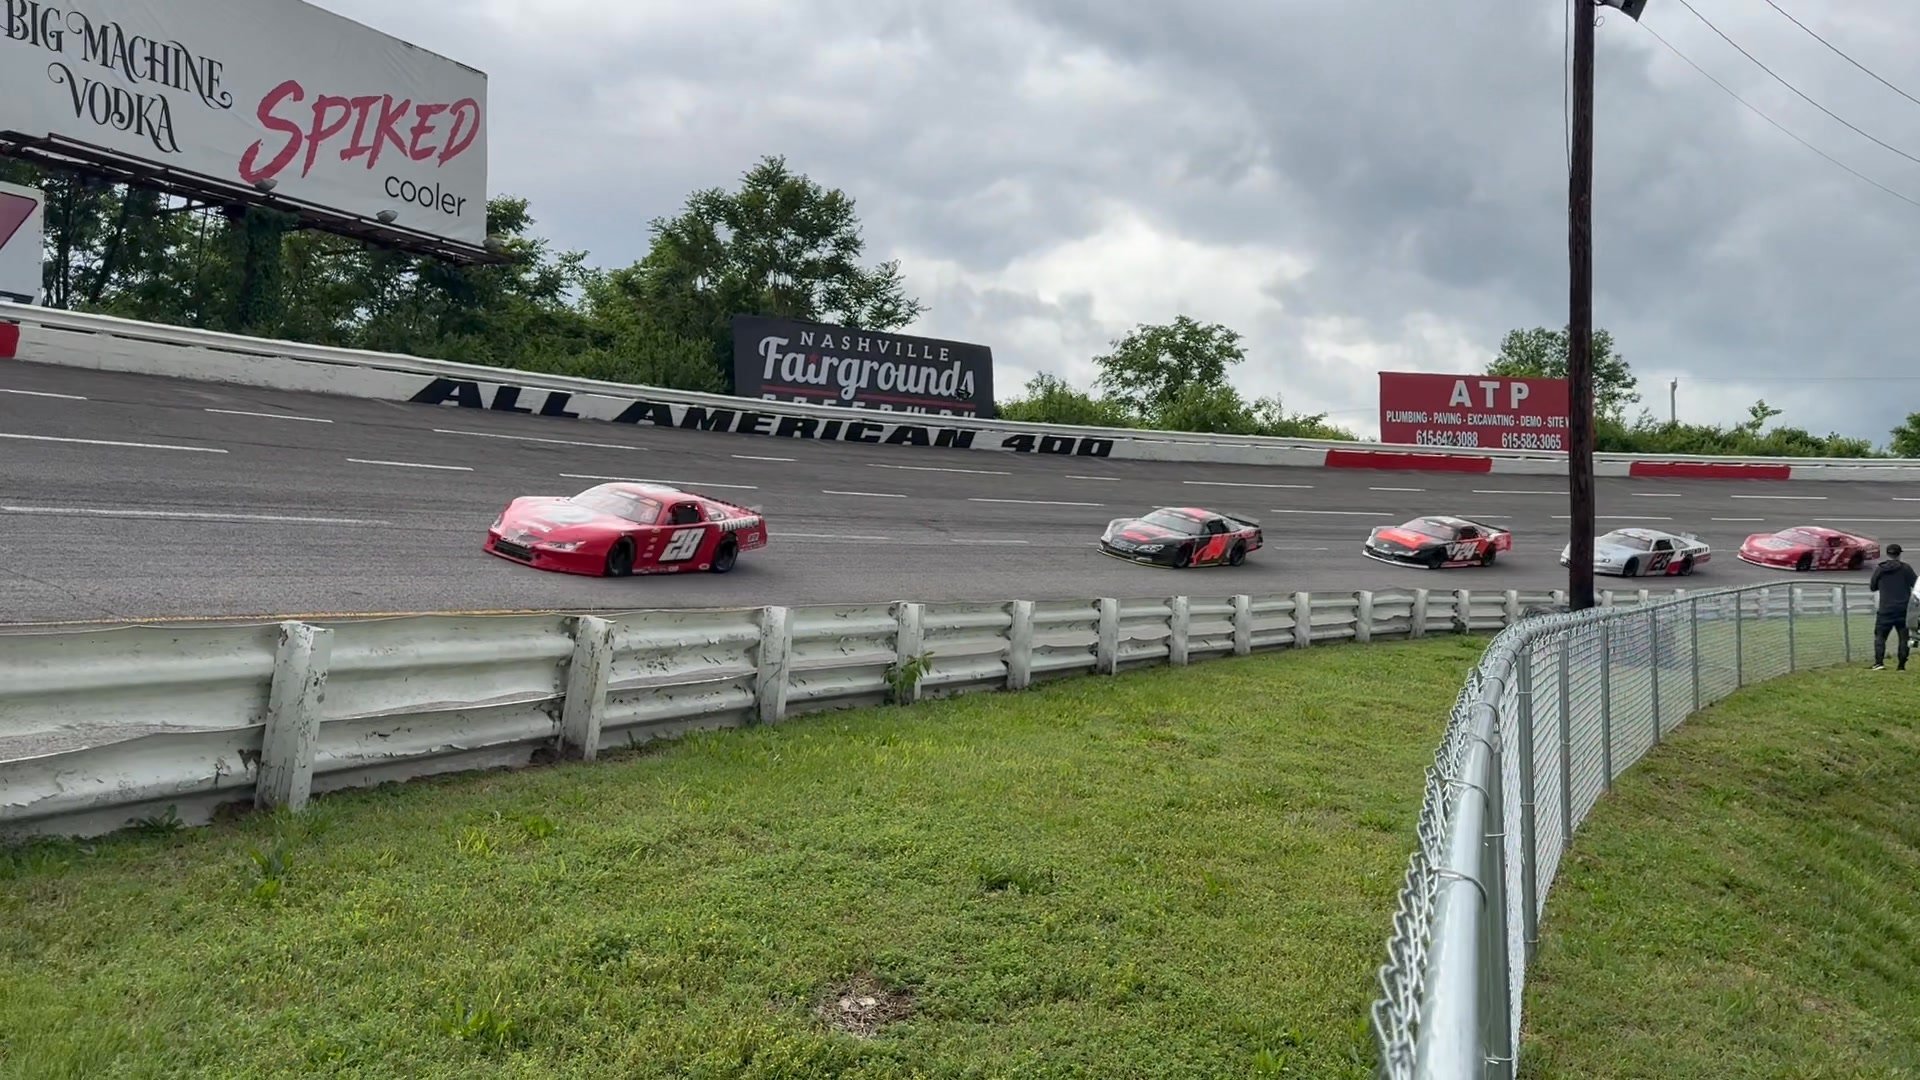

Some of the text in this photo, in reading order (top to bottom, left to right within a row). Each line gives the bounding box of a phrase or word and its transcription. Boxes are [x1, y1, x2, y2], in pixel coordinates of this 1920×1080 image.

[0, 0, 232, 110] BIG MACHINE
[48, 62, 181, 153] VODKA
[238, 80, 480, 184] SPIKED
[384, 173, 466, 217] cooler
[759, 336, 975, 400] Fairgrounds
[800, 331, 950, 362] NASHVILLE
[1449, 380, 1530, 409] ATP
[408, 377, 579, 418] ALL
[612, 400, 976, 449] AMERICAN
[1001, 434, 1114, 458] 400
[1386, 410, 1428, 423] PLUMBING
[1433, 412, 1461, 425] PAVING
[1467, 413, 1514, 427] EXCAVATING
[1520, 415, 1542, 428] DEMO
[1547, 416, 1564, 428] SITE
[1501, 432, 1562, 449] 615-582-3065
[657, 527, 706, 562] 28
